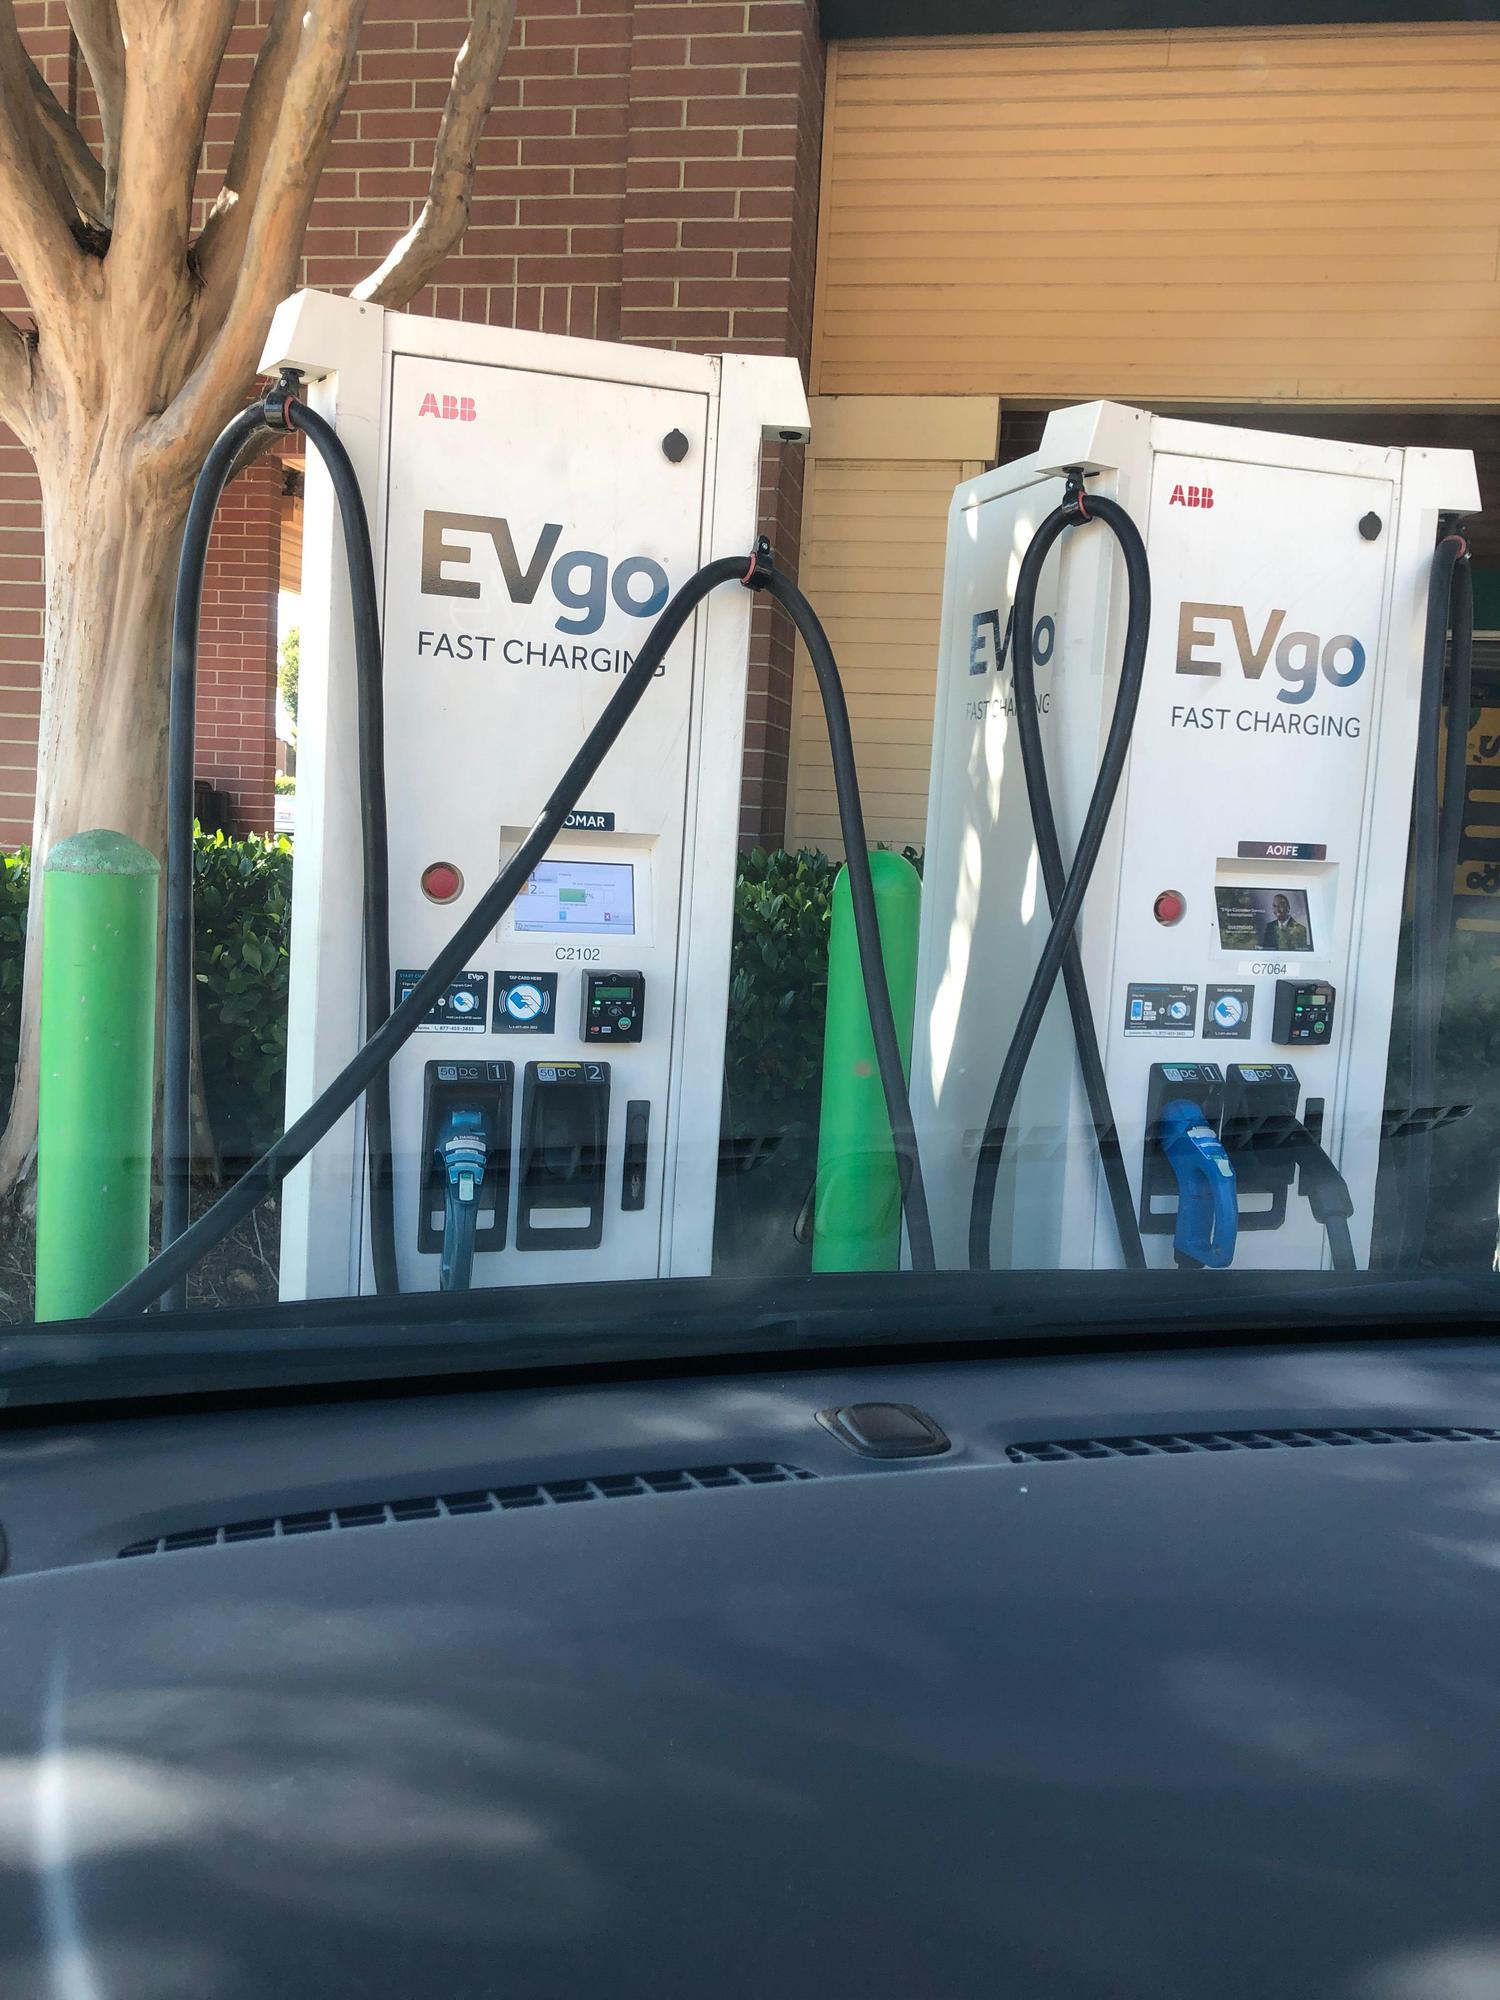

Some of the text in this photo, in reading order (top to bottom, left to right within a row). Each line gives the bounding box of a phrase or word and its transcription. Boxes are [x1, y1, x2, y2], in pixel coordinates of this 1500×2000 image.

[418, 393, 476, 422] ABB
[1169, 484, 1214, 509] ABB
[421, 509, 670, 636] EVgo
[417, 631, 496, 661] FAST
[969, 605, 1055, 688] EVo
[1176, 601, 1366, 704] EVgo
[1171, 706, 1360, 738] FAST CHARGING
[565, 814, 605, 828] OMAR
[1266, 845, 1299, 856] AOIFE
[555, 947, 600, 961] C2102
[1251, 963, 1287, 975] C7064
[467, 973, 484, 981] EVgo
[440, 1064, 500, 1079] 50 DC 1
[540, 1065, 602, 1080] 50 DC 2
[1180, 1069, 1197, 1077] DC
[1205, 1066, 1215, 1079] 1
[1257, 1070, 1273, 1078] DC
[1278, 1067, 1293, 1080] 2
